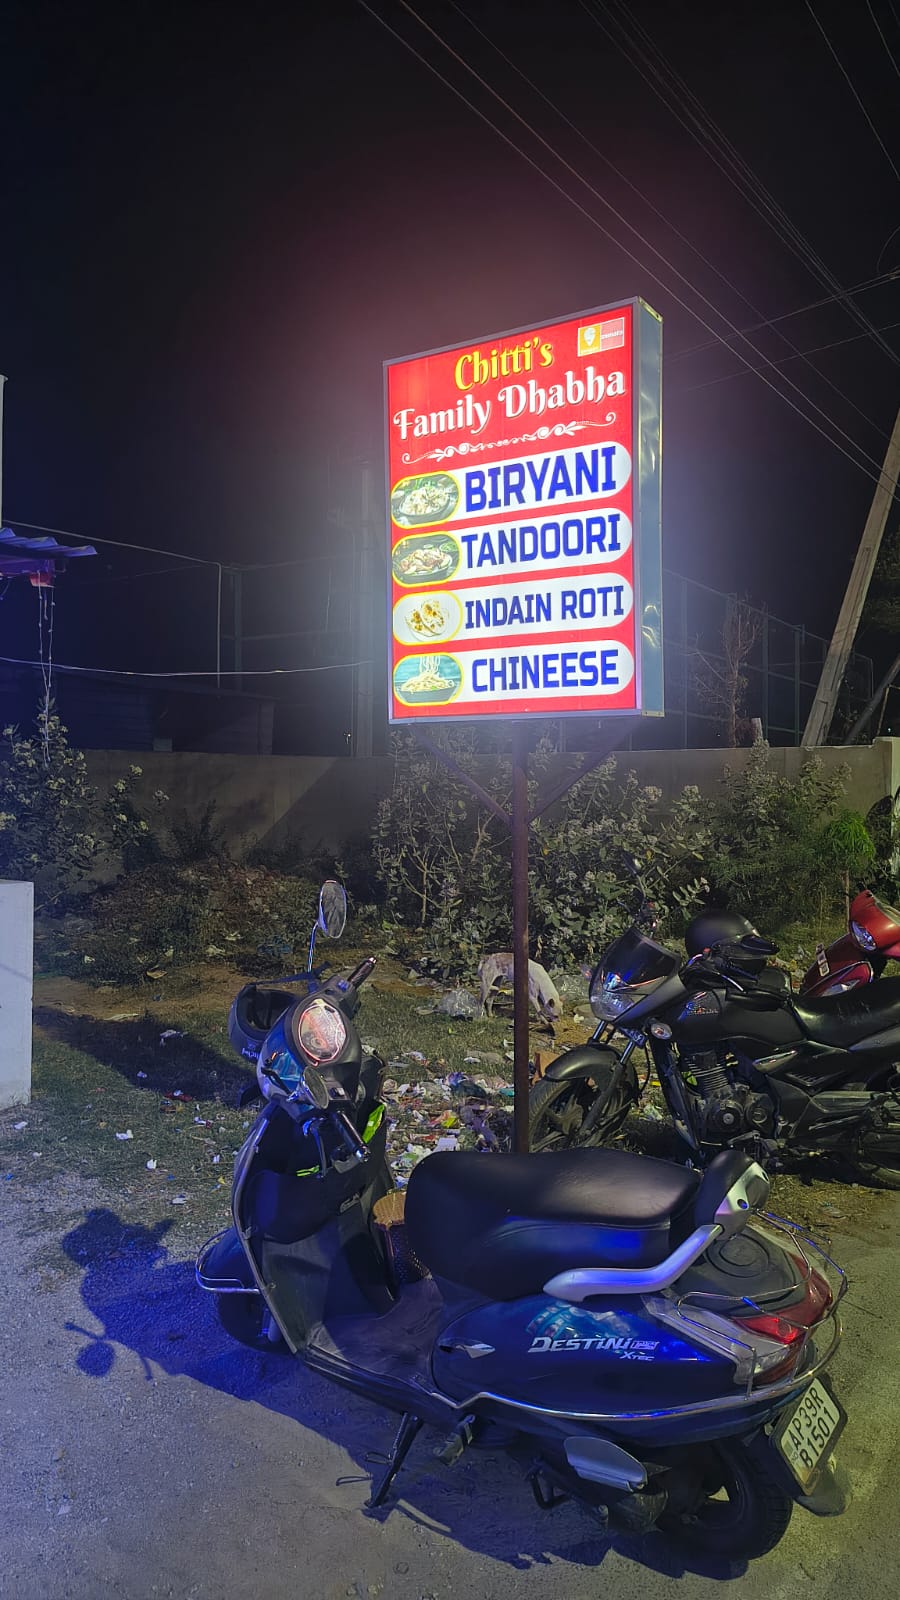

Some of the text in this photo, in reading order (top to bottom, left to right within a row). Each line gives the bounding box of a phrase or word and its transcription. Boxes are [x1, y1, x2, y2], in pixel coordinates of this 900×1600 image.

[454, 337, 553, 390] Chitti's
[393, 366, 625, 440] Family Dhabha
[465, 446, 616, 513] BIRYANI
[461, 514, 621, 569] TANDOORI
[465, 586, 624, 629] INDAIN ROTI
[472, 650, 619, 692] CHINEESE
[788, 1387, 824, 1450] AP39R
[799, 1407, 836, 1469] B1501
